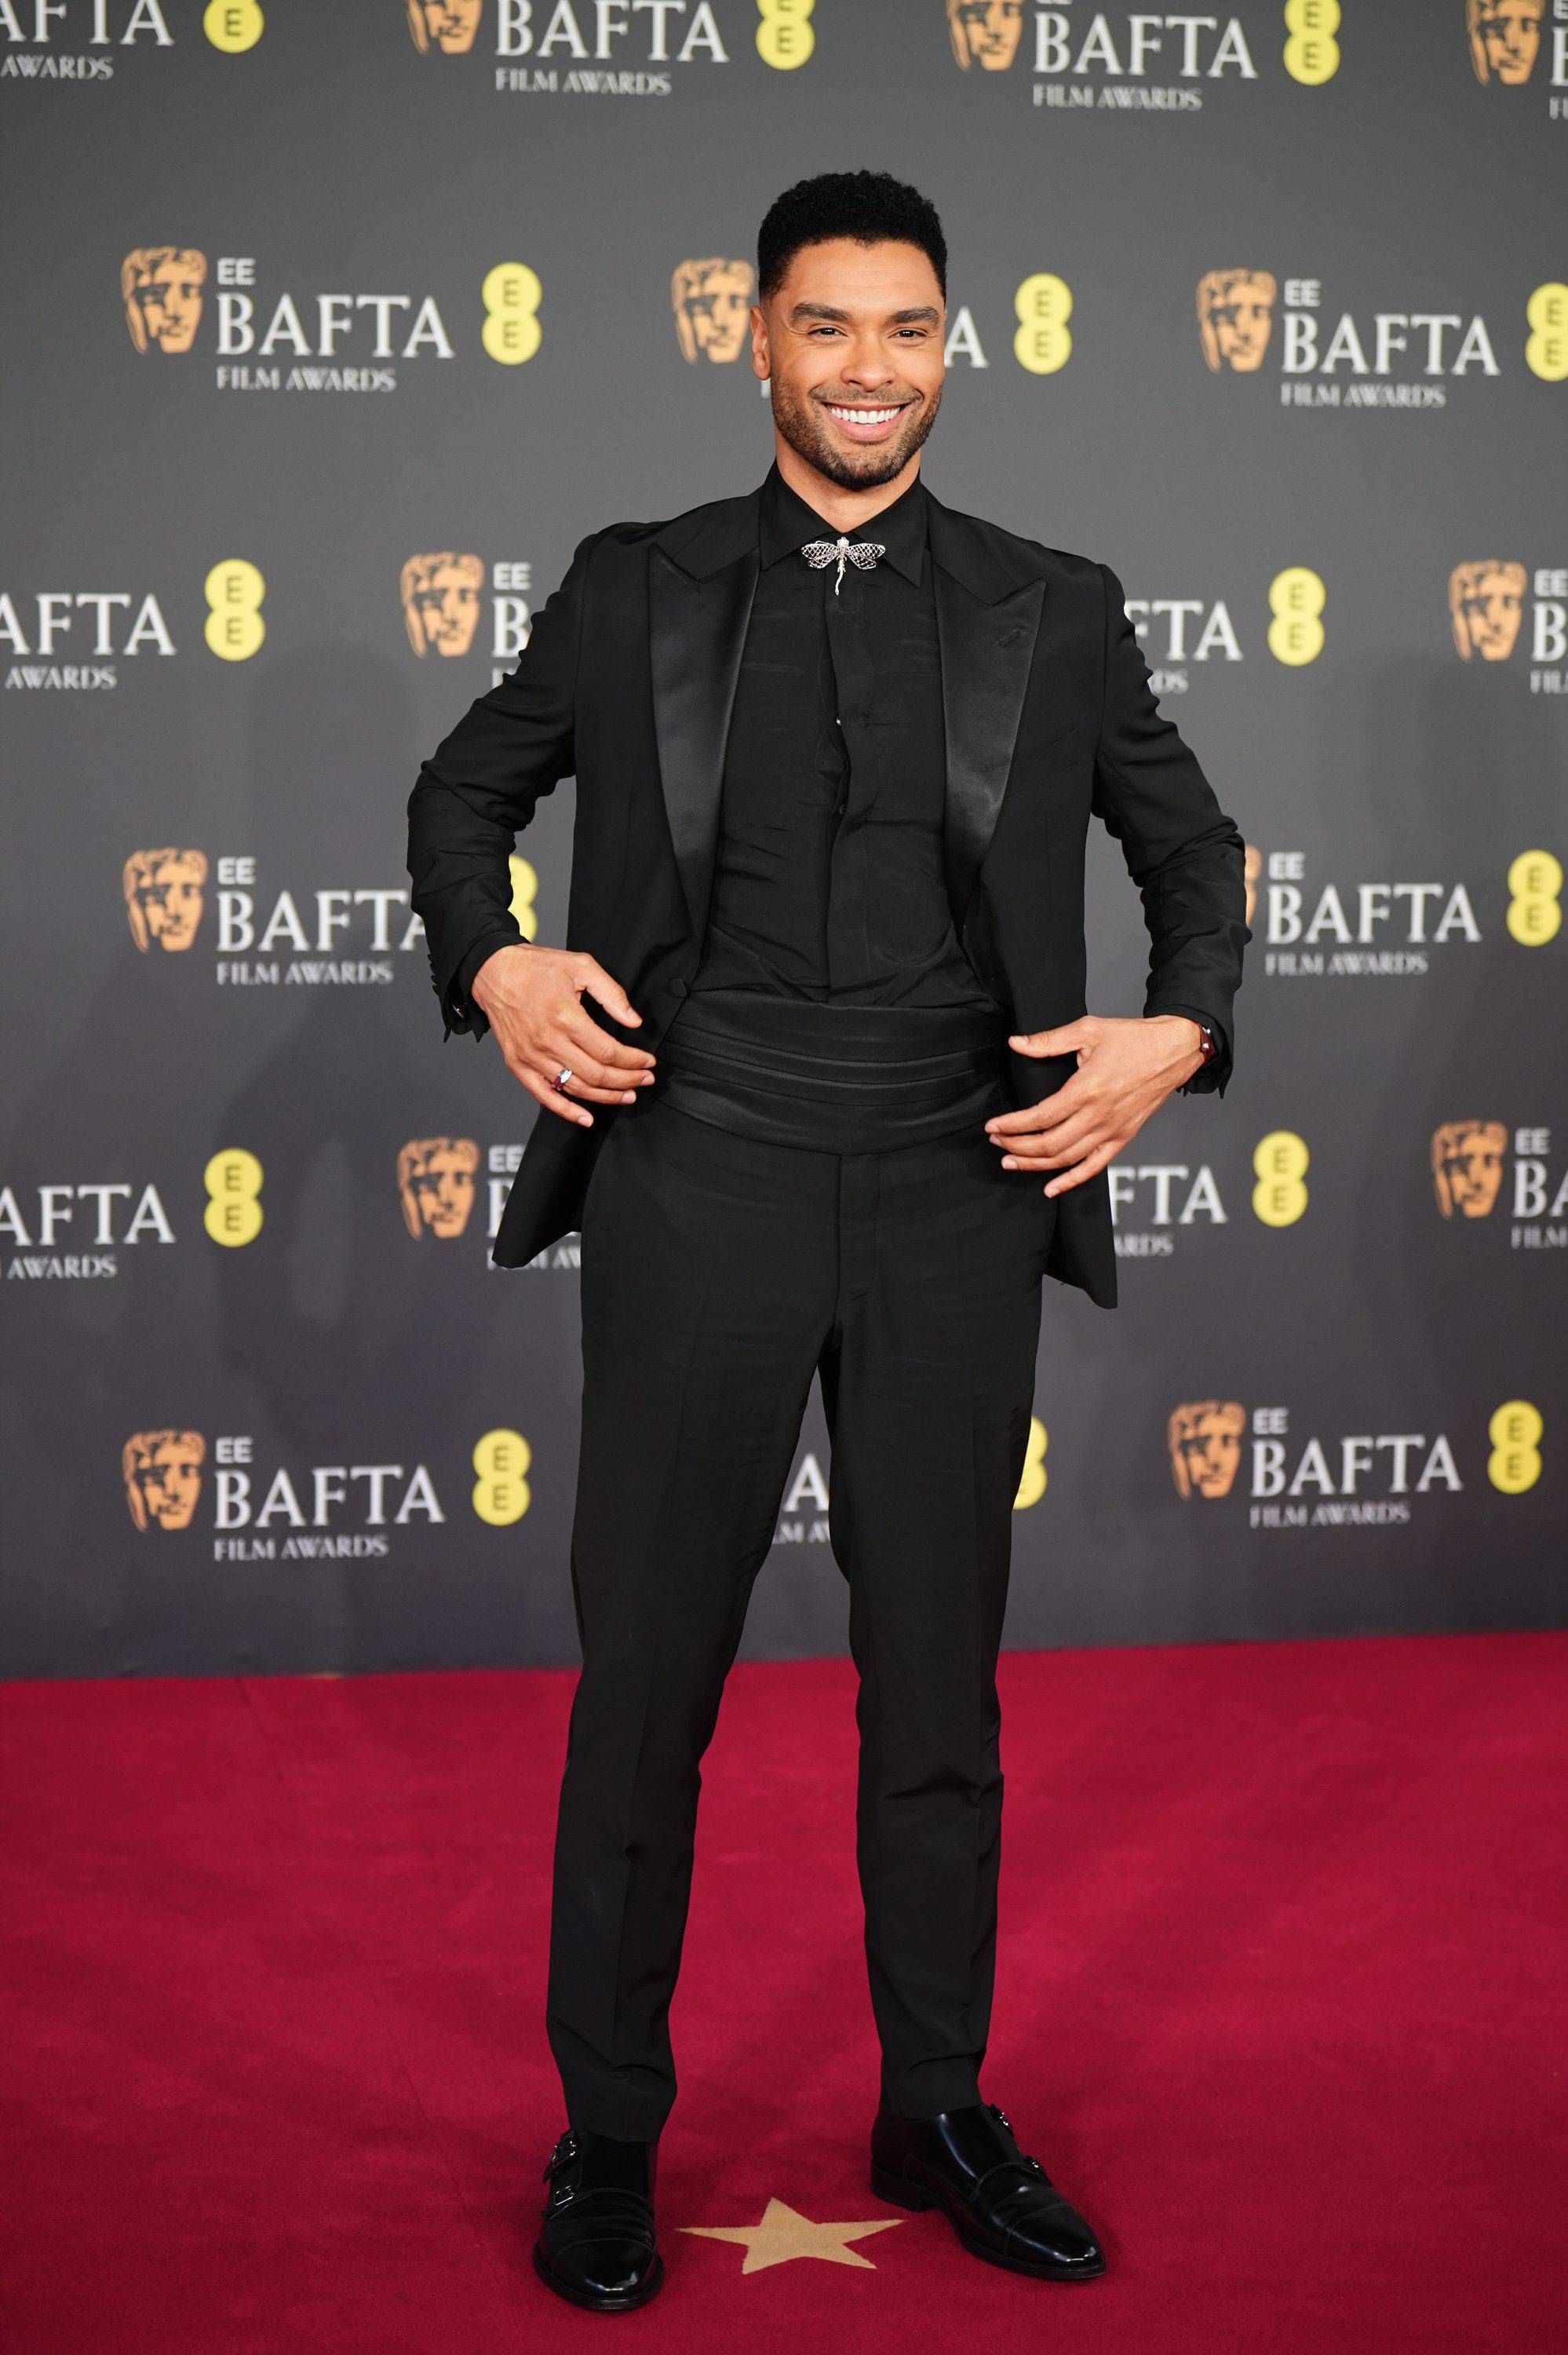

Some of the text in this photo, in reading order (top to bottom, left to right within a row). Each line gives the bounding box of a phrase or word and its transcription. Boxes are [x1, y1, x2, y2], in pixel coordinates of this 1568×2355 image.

[496, 0, 729, 63] BAFTA
[1033, 12, 1258, 78] BAFTA
[0, 54, 115, 79] AWARDS
[495, 68, 672, 94] FILM AWARDS
[1033, 84, 1203, 111] FILM AWARDS
[217, 257, 256, 286] EE
[1284, 279, 1322, 308] EE
[217, 292, 455, 359] BAFTA
[1282, 312, 1501, 376] BAFTA
[217, 366, 397, 392] FILM AWARDS
[1280, 382, 1446, 408] FILM AWARDS
[494, 562, 532, 590] EE
[0, 593, 177, 656] AFTA
[5, 666, 118, 690] AWARDS
[1530, 670, 1568, 694] FIL
[218, 857, 256, 885] EE
[1267, 851, 1307, 881] EE
[1266, 883, 1482, 944] BAFTA
[217, 961, 394, 986] FILM AWARDS
[1265, 951, 1429, 977] FILM AWARDS
[1515, 1127, 1551, 1156] EE
[1107, 1164, 1228, 1226] FTA
[0, 1183, 177, 1247] AFTA
[1511, 1226, 1568, 1250] FILM
[7, 1254, 118, 1280] AWARDS
[1253, 1407, 1289, 1435] EE
[215, 1436, 253, 1464] EE
[1250, 1434, 1464, 1499] BAFTA
[213, 1464, 447, 1529] BAFTA
[1249, 1501, 1411, 1528] FILM AWARDS
[213, 1534, 389, 1562] FILM AWARDS
